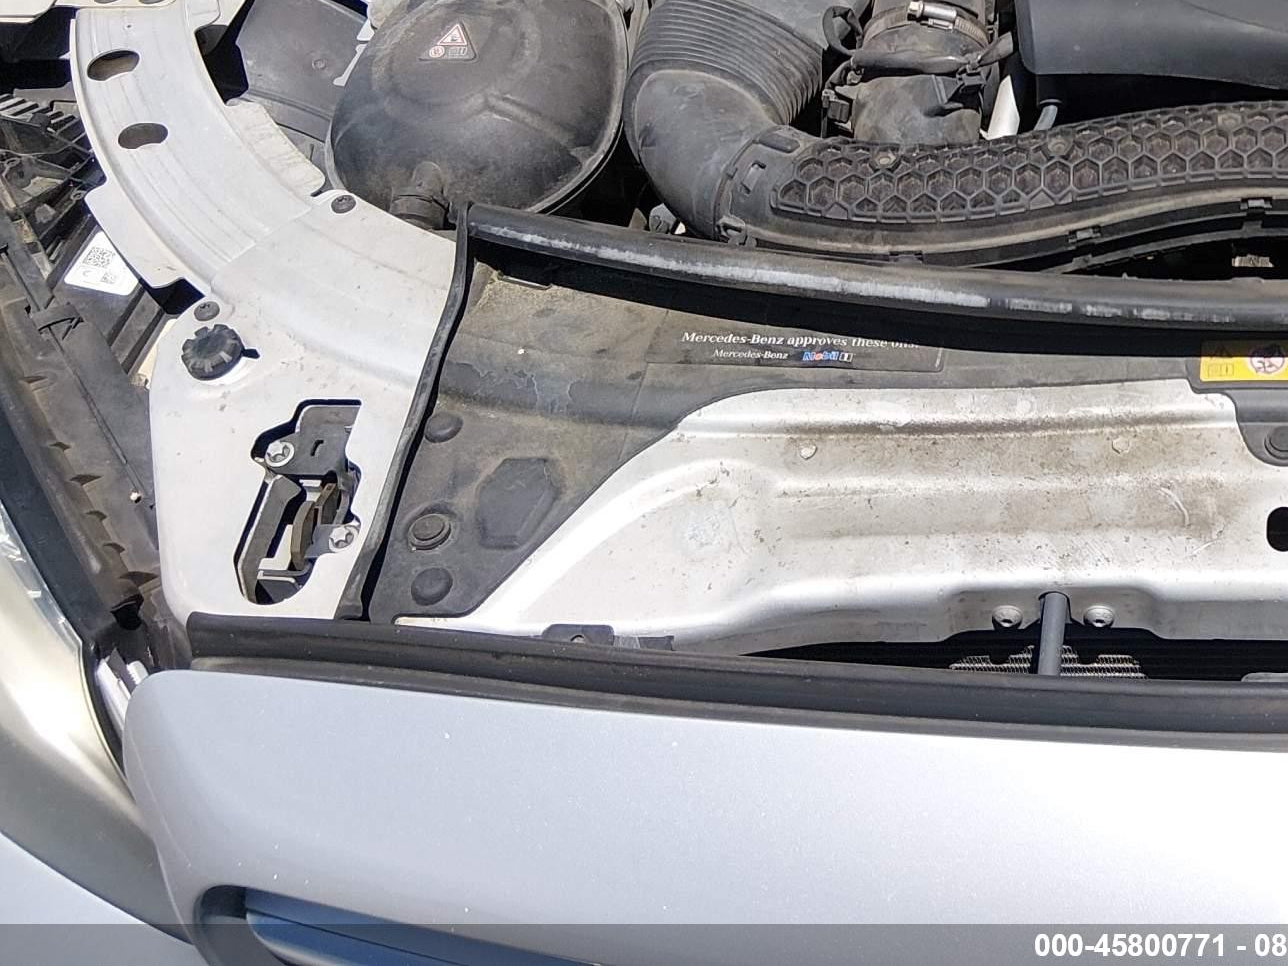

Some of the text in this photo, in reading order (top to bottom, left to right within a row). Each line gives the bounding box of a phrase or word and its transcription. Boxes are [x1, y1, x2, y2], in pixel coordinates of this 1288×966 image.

[681, 332, 785, 345] Mercedes-Benz
[787, 335, 848, 347] approves
[851, 337, 888, 348] these
[713, 349, 789, 360] Mercedes-Benz
[802, 350, 839, 362] Mobil
